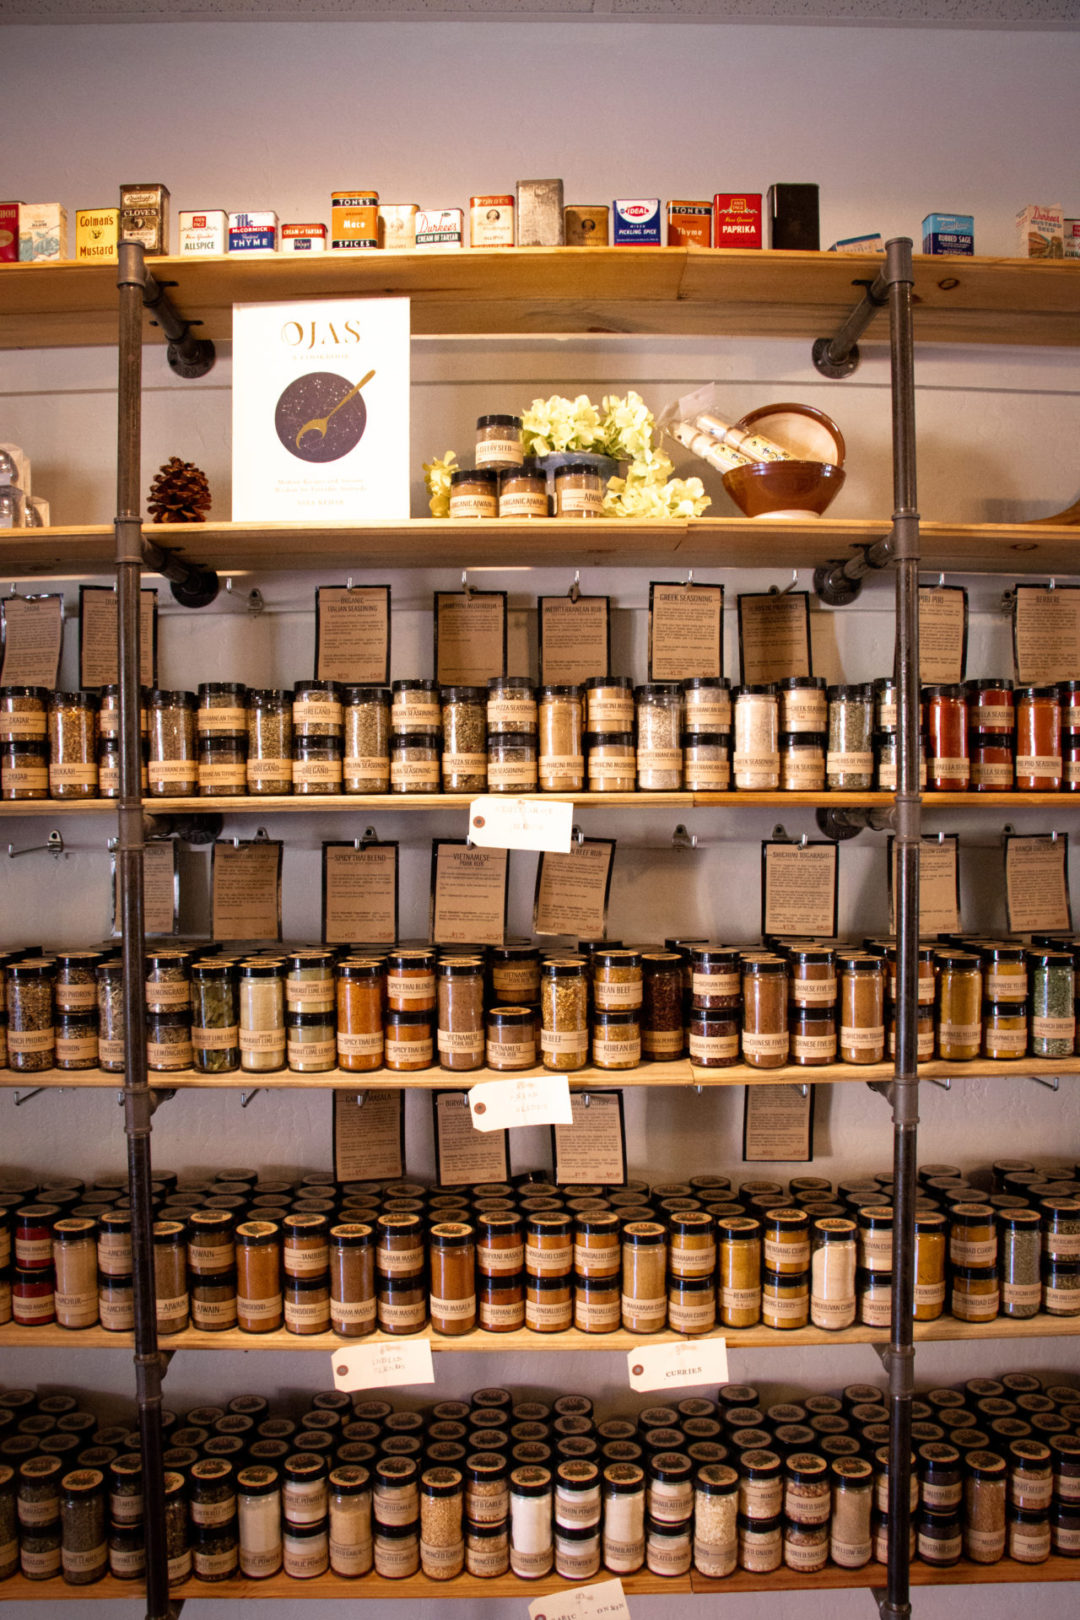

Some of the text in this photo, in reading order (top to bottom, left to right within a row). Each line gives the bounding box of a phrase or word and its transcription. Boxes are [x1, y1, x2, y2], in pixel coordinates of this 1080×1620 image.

[123, 209, 157, 217] CLOVES
[626, 207, 648, 216] IDEAL
[80, 215, 114, 227] Colman's
[343, 219, 365, 229] Mace
[677, 228, 702, 238] Thyme
[722, 225, 756, 234] PAPRIKA
[440, 233, 459, 242] TARTAR
[958, 236, 972, 244] SAGE
[184, 242, 215, 250] ALLSPICE
[233, 238, 268, 246] THYME
[338, 240, 370, 248] SPICES
[80, 245, 113, 257] Mustard
[281, 320, 361, 350] OJAS
[680, 595, 713, 603] SEASONING
[353, 854, 368, 862] THAI
[370, 854, 386, 862] BLEND
[453, 853, 490, 861] VIETNAMESE
[617, 985, 631, 993] BEEF
